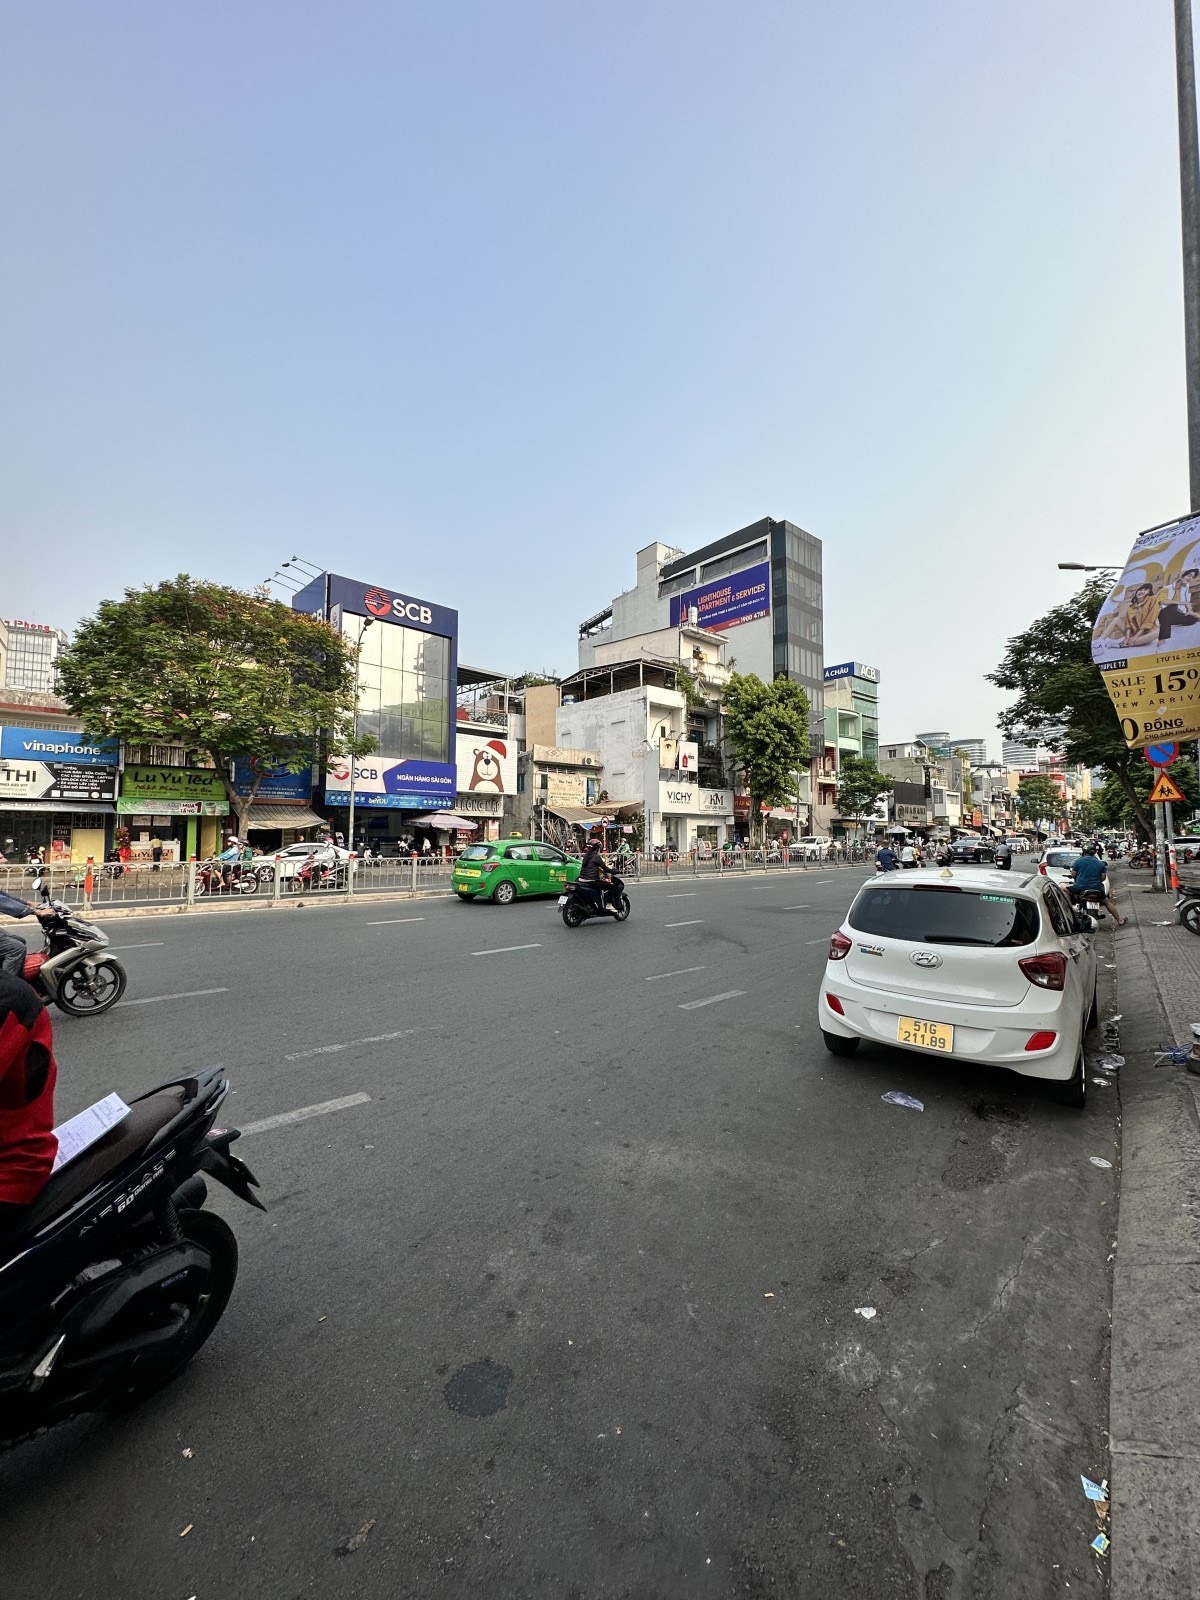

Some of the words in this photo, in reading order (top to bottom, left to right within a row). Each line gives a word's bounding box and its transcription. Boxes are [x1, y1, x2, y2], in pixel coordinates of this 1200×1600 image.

[698, 586, 732, 604] LIGHTHOUSE
[698, 595, 731, 612] APARTMENT
[736, 584, 766, 600] SERVICES
[393, 599, 433, 625] SCB
[741, 615, 752, 623] 1900
[830, 667, 848, 676] CHÂU
[860, 664, 876, 680] ACB
[1112, 676, 1145, 688] SALE
[1114, 688, 1146, 698] OFF
[1149, 695, 1200, 706] ARRIV
[1144, 718, 1184, 731] ĐỒNG
[1144, 732, 1159, 740] CHO
[23, 740, 101, 755] vinaphone
[2, 769, 36, 782] THI
[134, 771, 156, 783] Lu
[160, 772, 181, 784] Yu
[354, 768, 378, 780] SCB
[414, 775, 430, 783] HÀNG
[431, 776, 439, 784] SÀI
[440, 776, 452, 784] GÒN
[667, 791, 692, 801] VICHY
[710, 793, 723, 805] KM
[905, 806, 926, 815] HASAKI
[914, 1021, 937, 1034] 51G
[903, 1031, 946, 1048] 211.89
[118, 1194, 135, 1213] 60
